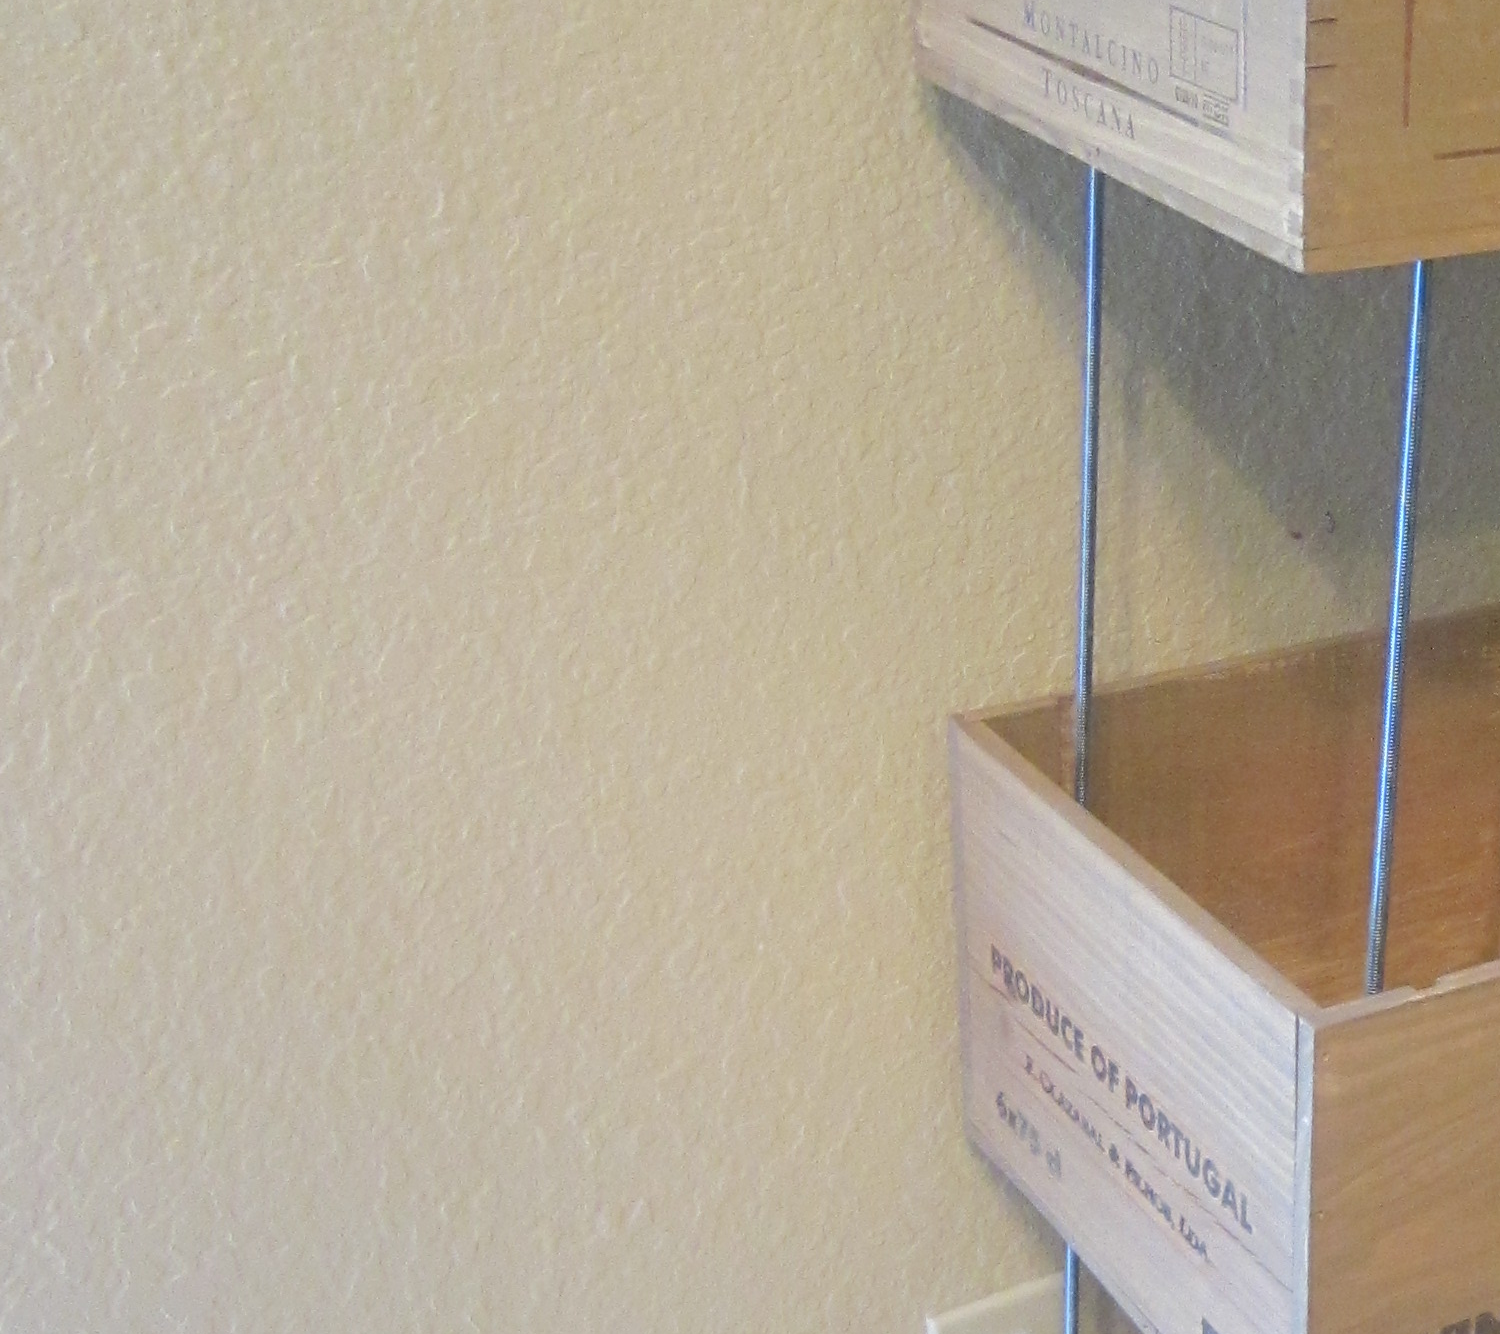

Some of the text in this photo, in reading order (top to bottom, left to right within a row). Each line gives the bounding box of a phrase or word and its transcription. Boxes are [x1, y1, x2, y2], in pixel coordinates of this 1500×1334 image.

[1022, 0, 1161, 84] MONTALCINO
[1041, 66, 1138, 142] TOSCANA
[989, 942, 1254, 1235] PRODUCE OF PORTUGAL
